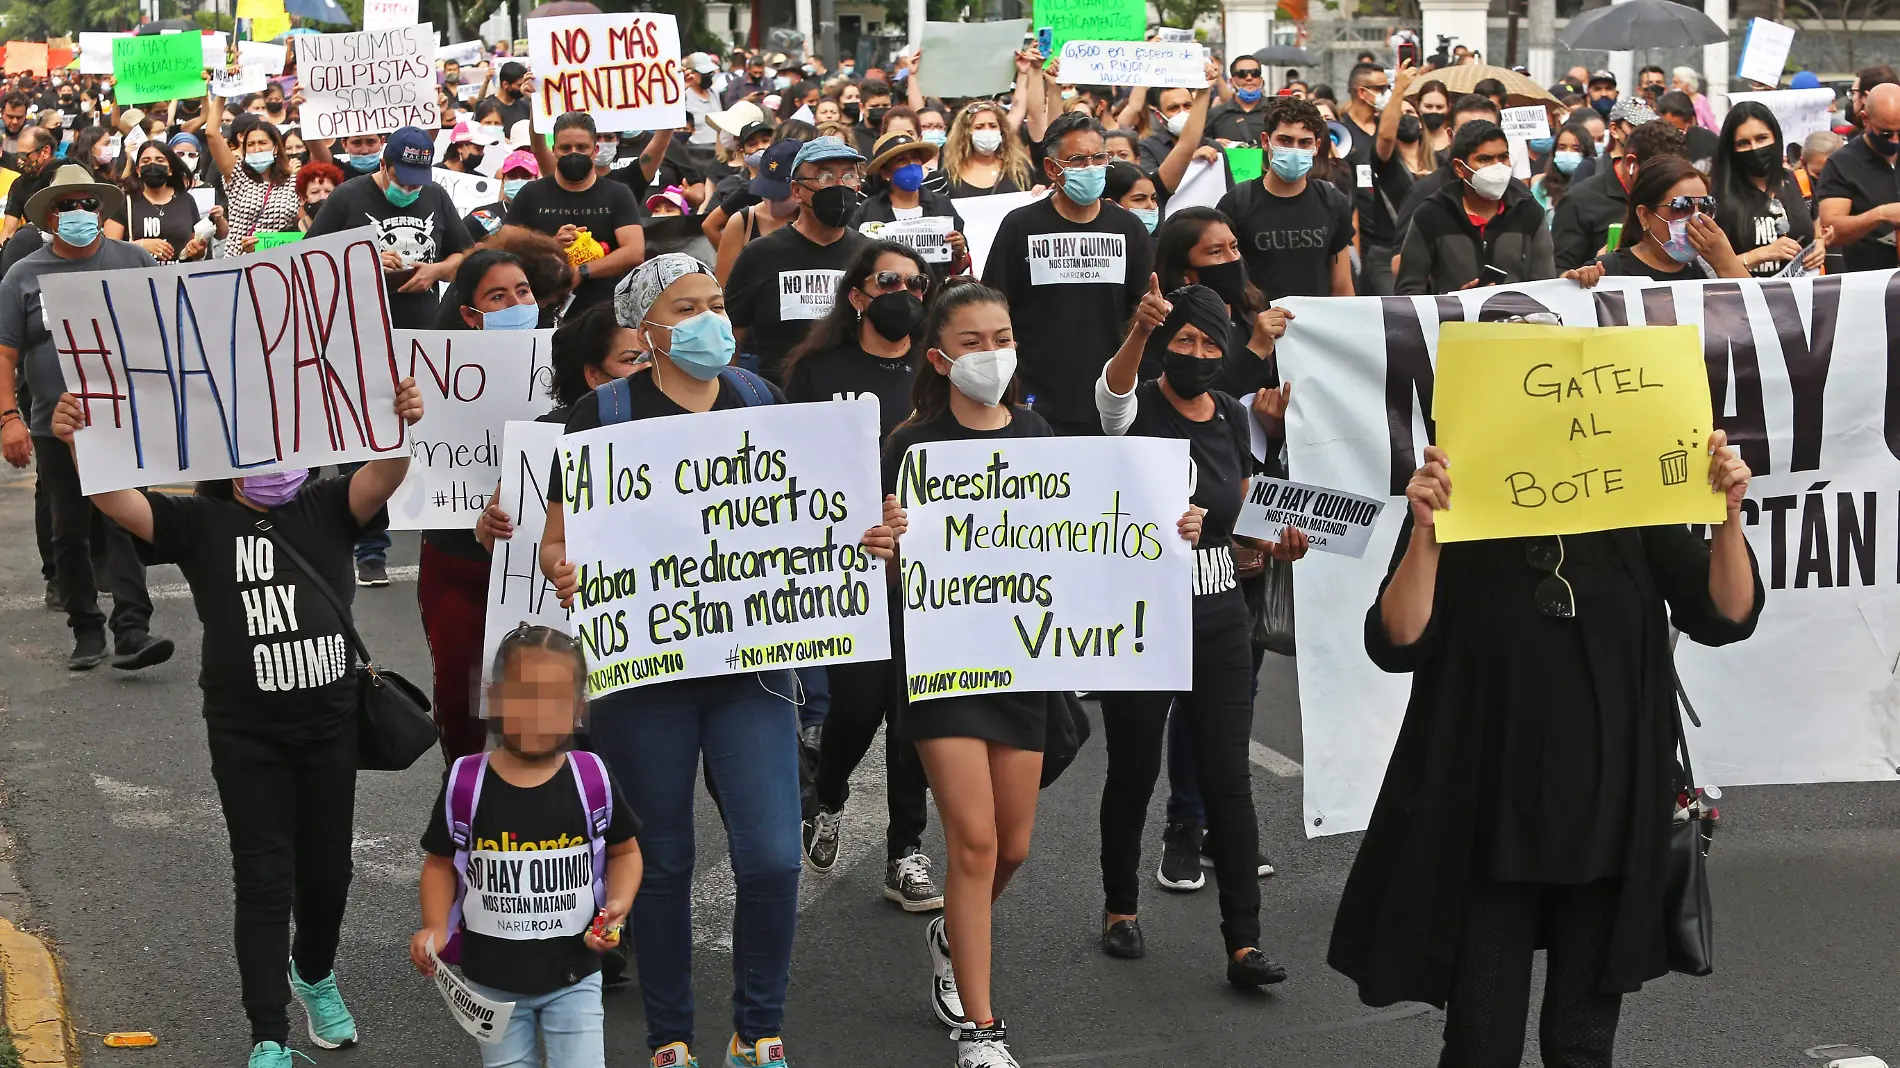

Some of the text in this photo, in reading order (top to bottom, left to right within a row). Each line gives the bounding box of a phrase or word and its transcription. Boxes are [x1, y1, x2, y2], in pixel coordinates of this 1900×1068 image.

[1045, 13, 1132, 30] MEDICAMENTOS
[117, 39, 169, 57] NO HAY
[301, 36, 334, 62] NO
[344, 28, 417, 62] SOMOS
[551, 18, 660, 66] NO MÁS
[1065, 43, 1194, 60] 6,500 en espera de
[123, 57, 196, 78] HEMODIALISIS
[310, 55, 429, 92] GOLPISTAS
[1091, 62, 1104, 71] un
[1155, 66, 1167, 76] en
[1099, 72, 1142, 84] JALISCO
[335, 82, 416, 110] SOMOS
[543, 58, 680, 117] MENTIRAS
[318, 102, 436, 136] OPTIMISTAS
[1514, 110, 1545, 121] QUIMIO
[143, 217, 161, 238] NO
[382, 216, 424, 230] PERRO
[898, 235, 915, 246] HAY
[915, 234, 945, 246] QUIMIO
[1254, 229, 1325, 250] GUESS
[1754, 216, 1778, 245] NO
[1032, 237, 1123, 259] NO HAY QUIMIO
[1049, 258, 1110, 269] NOS ESTÁN MATANDO
[783, 275, 801, 294] NO
[805, 275, 830, 294] HAY
[800, 295, 814, 304] NOS
[1523, 363, 1663, 402] GATEL
[1593, 275, 1842, 478] AY
[1569, 413, 1611, 441] AL
[608, 442, 651, 505] los
[674, 430, 787, 495] cuantos
[901, 449, 1071, 509] Necesitamos
[701, 476, 848, 534] muertos
[1250, 481, 1378, 527] NO HAY QUIMIO
[1505, 469, 1624, 508] BOTE
[945, 490, 1163, 561] Medicamentos
[1264, 509, 1348, 537] NOS ESTÁN MATANDO
[236, 536, 274, 582] NO
[1192, 545, 1237, 596] IMIO
[566, 560, 637, 621] Habra
[241, 585, 299, 637] HAY
[579, 610, 629, 661] NOS
[744, 572, 870, 627] matando
[1013, 600, 1147, 660] Vivir!
[253, 633, 347, 692] QUIMIO
[466, 852, 590, 894] NO HAY QUIMIO
[482, 892, 577, 914] NOS ESTÁN MATANDO
[497, 918, 563, 932] NARIZROJA
[438, 968, 455, 993] HAY
[453, 988, 495, 1022] QUIMIO
